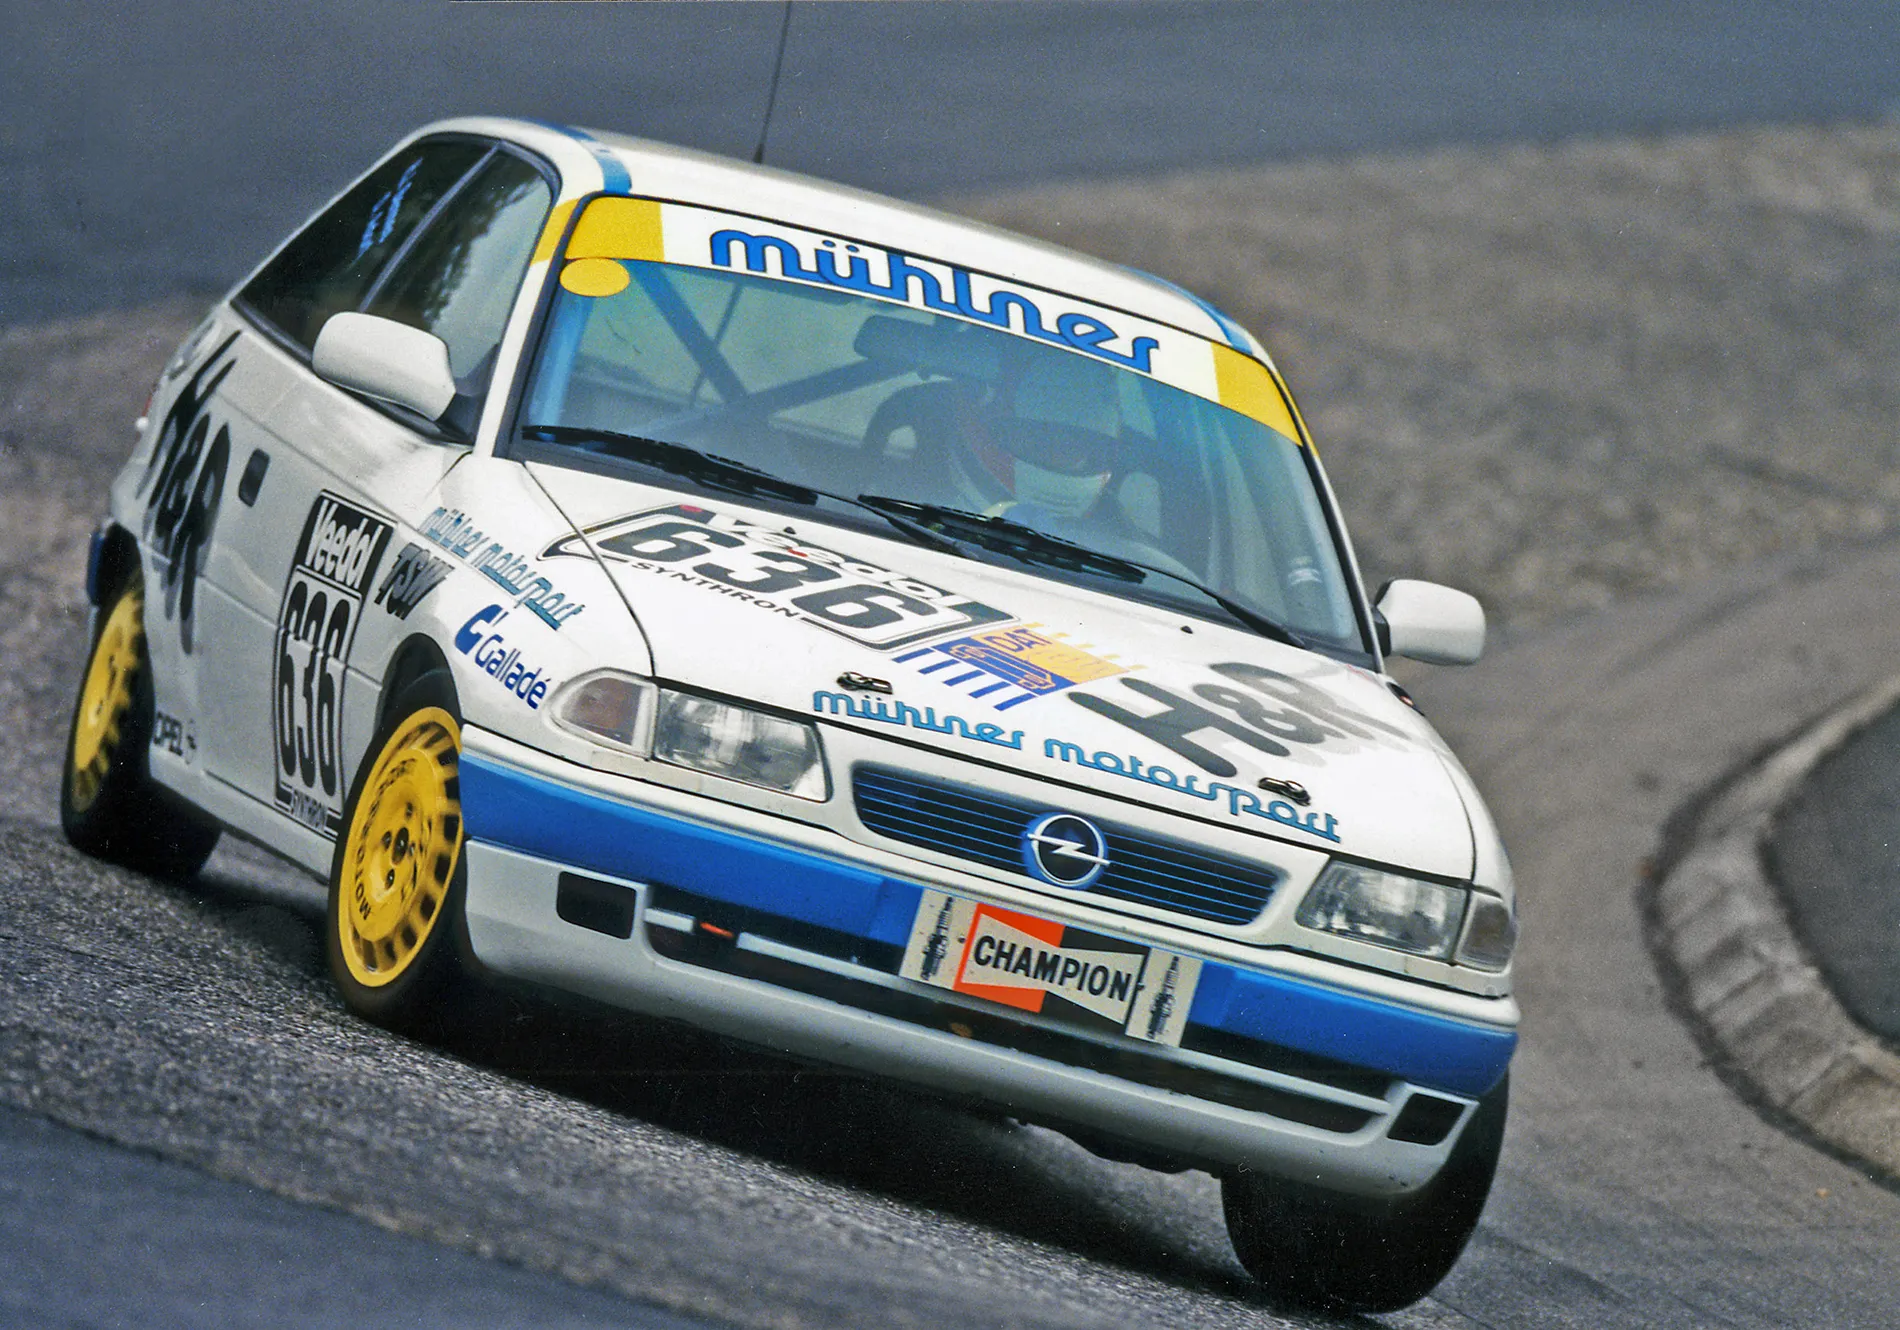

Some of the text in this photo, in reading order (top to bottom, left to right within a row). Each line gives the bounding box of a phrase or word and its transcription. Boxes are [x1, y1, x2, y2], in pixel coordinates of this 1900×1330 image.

[709, 229, 1160, 374] mühlner
[306, 499, 385, 589] Veedol
[470, 543, 586, 632] motorsport
[597, 521, 938, 629] 636
[632, 561, 804, 618] SYNTHRON
[703, 513, 972, 606] Veedol
[475, 634, 552, 711] Galladé
[983, 628, 1053, 653] DAT
[278, 580, 350, 797] 636
[1066, 662, 1412, 778] H&R
[813, 690, 1341, 843] mühlner motorsport
[973, 915, 1132, 1002] CHAMPION
